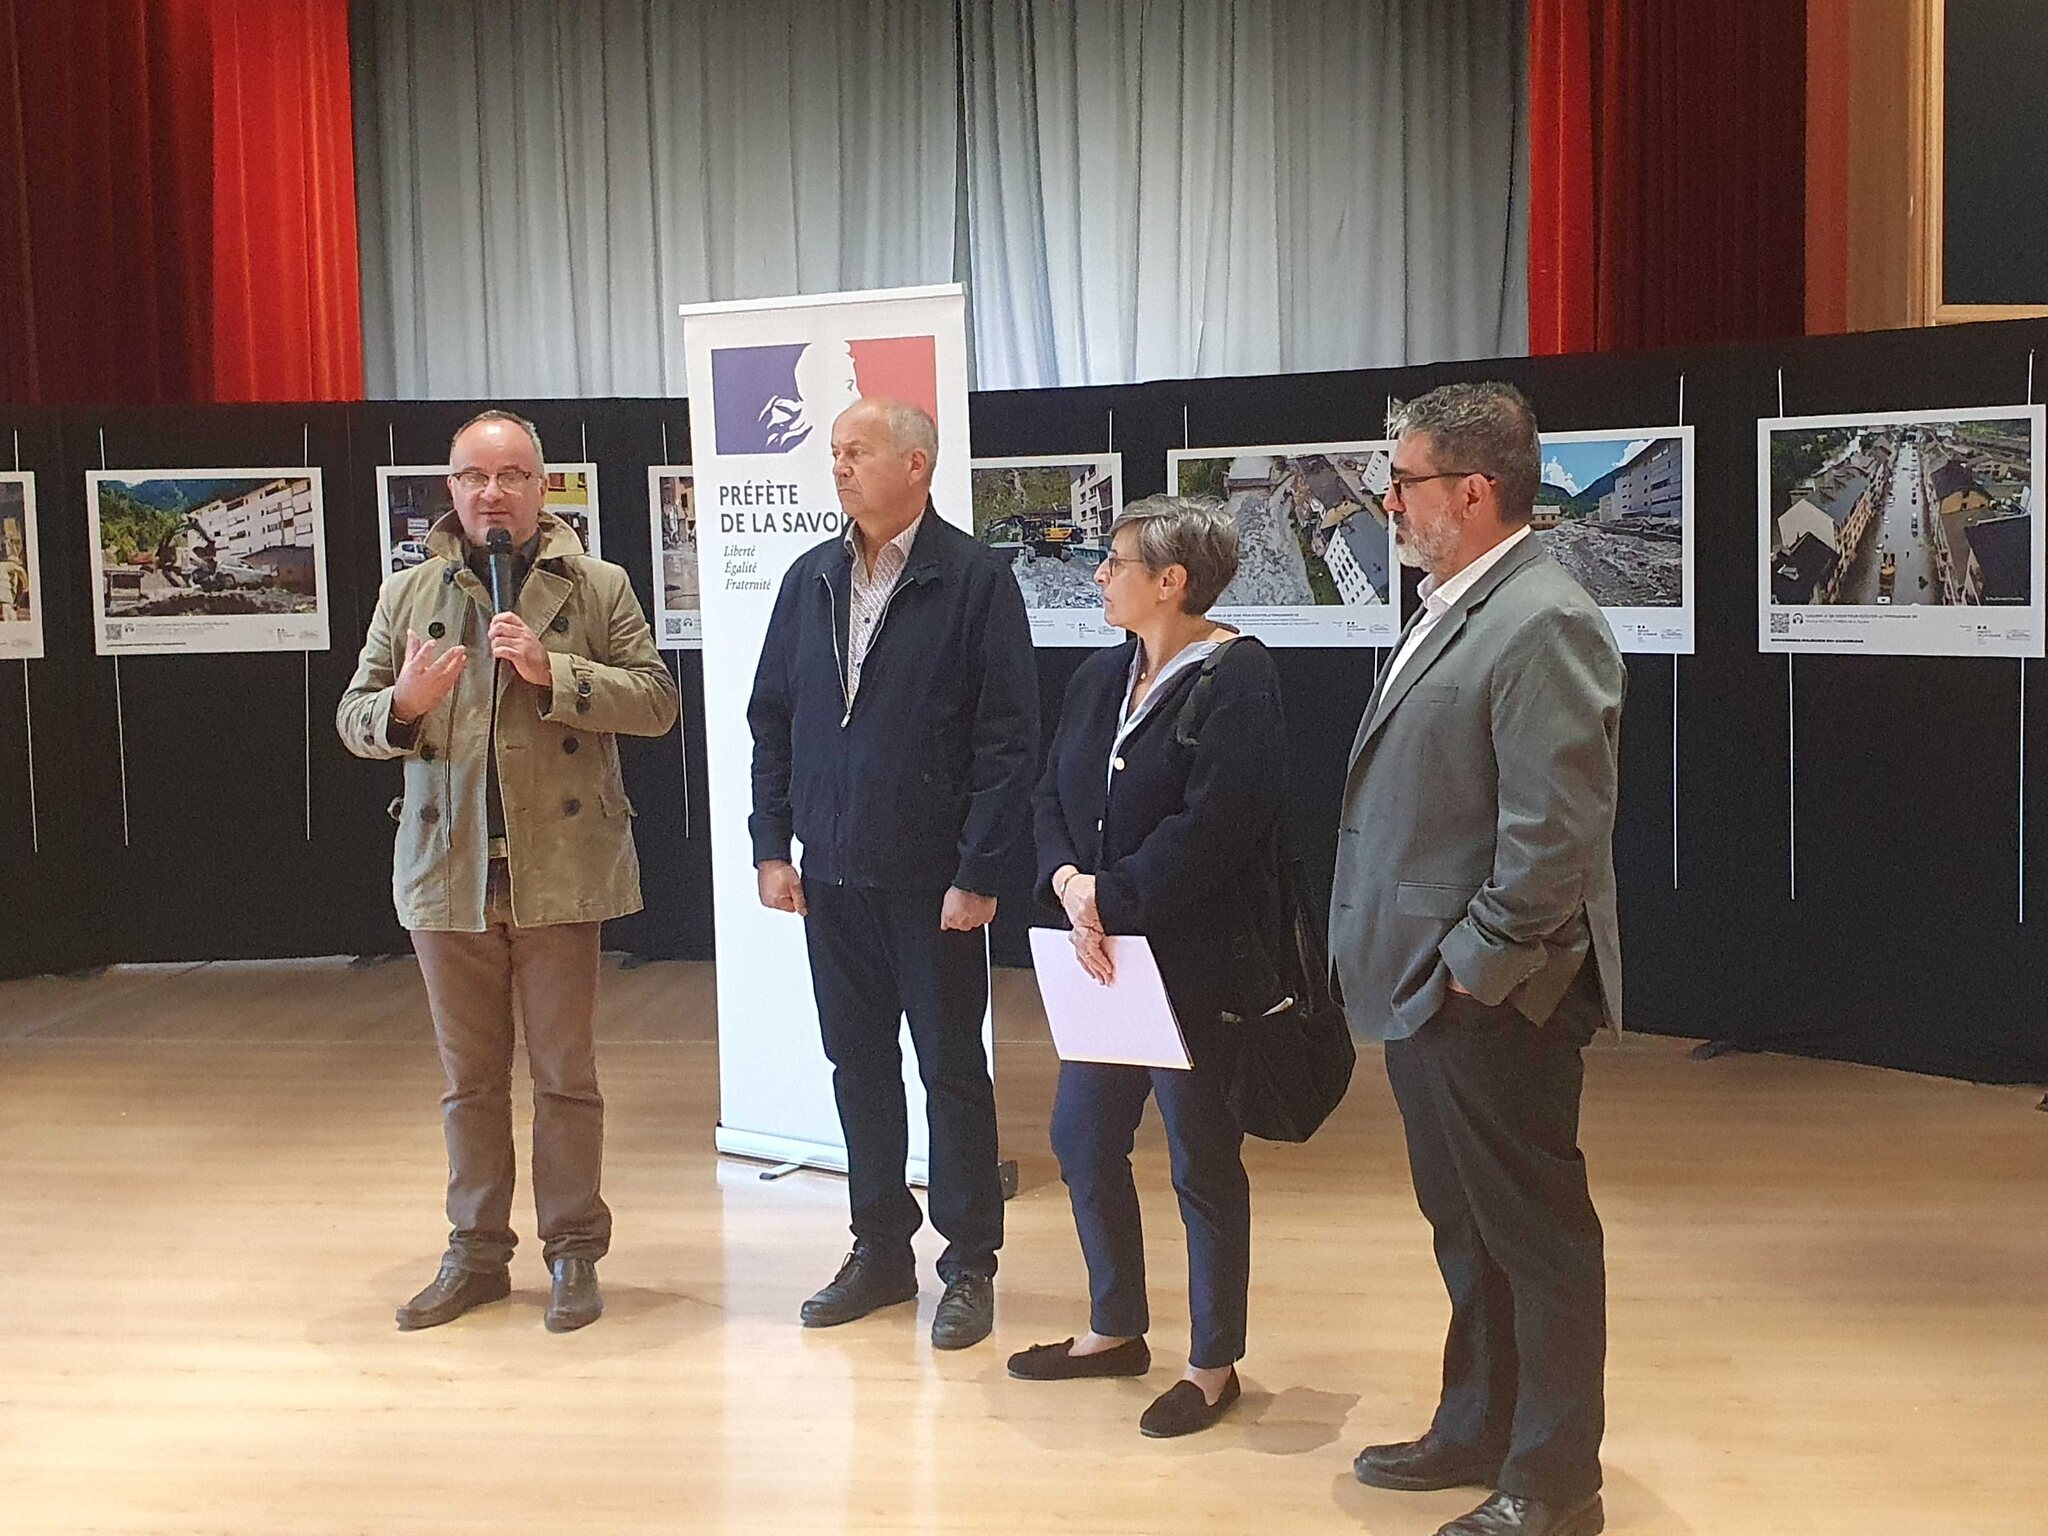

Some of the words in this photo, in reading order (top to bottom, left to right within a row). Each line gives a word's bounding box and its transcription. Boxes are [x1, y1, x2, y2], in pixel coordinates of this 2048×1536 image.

[719, 479, 799, 506] PRÉFÈTE
[721, 513, 746, 533] DE
[752, 512, 777, 533] LA
[782, 511, 845, 533] SAVOI
[723, 544, 757, 557] Liberté
[724, 559, 758, 577] Égalité
[725, 578, 772, 590] Fraternité
